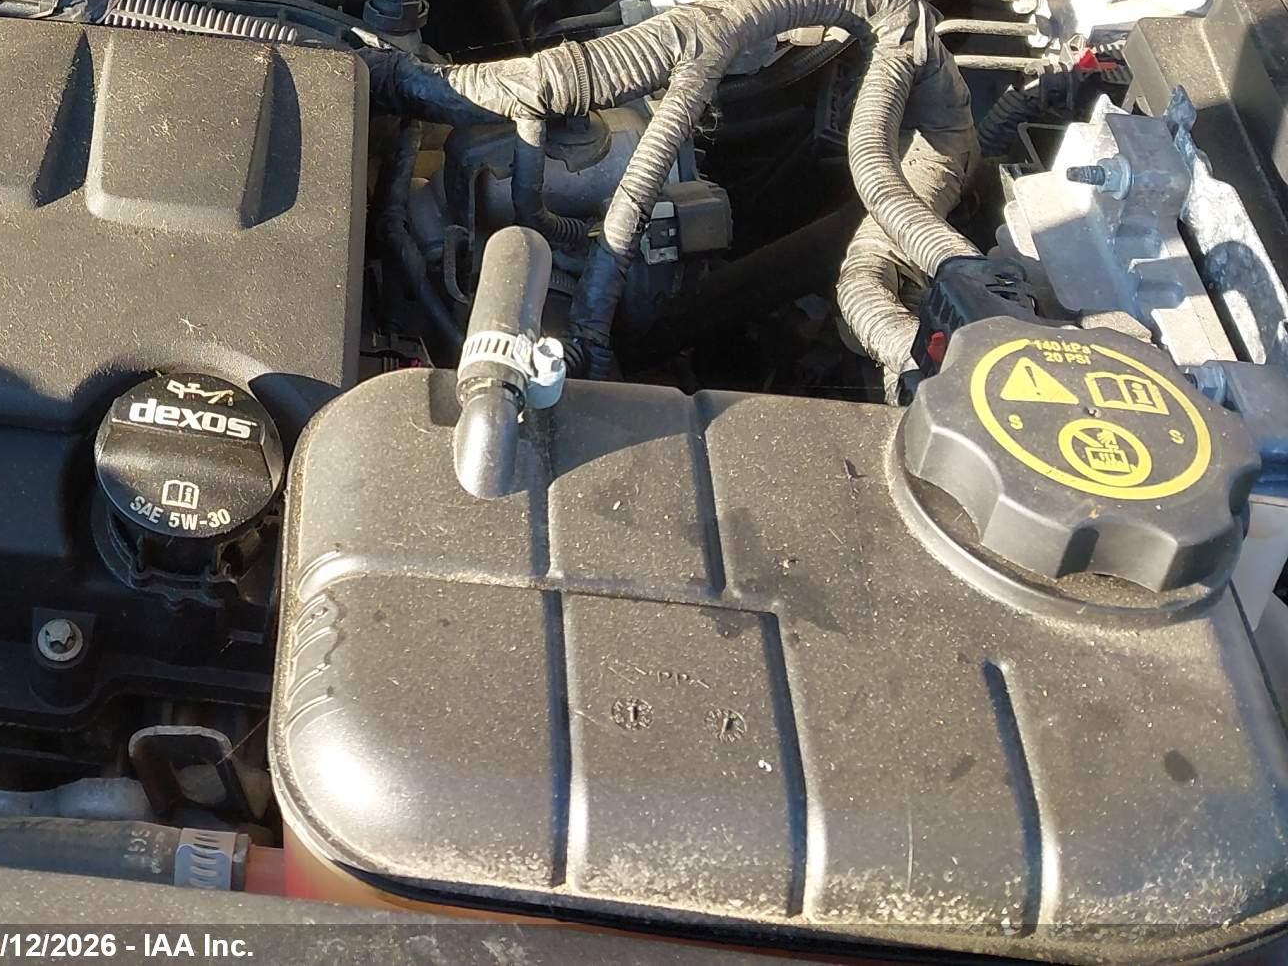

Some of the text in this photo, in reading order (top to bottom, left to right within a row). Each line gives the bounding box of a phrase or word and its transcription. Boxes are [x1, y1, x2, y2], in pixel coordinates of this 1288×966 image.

[1033, 339, 1092, 355] 140 kPa
[1043, 351, 1092, 365] 20 PSI
[128, 398, 252, 439] dexos
[130, 495, 231, 531] SAE 5W-30
